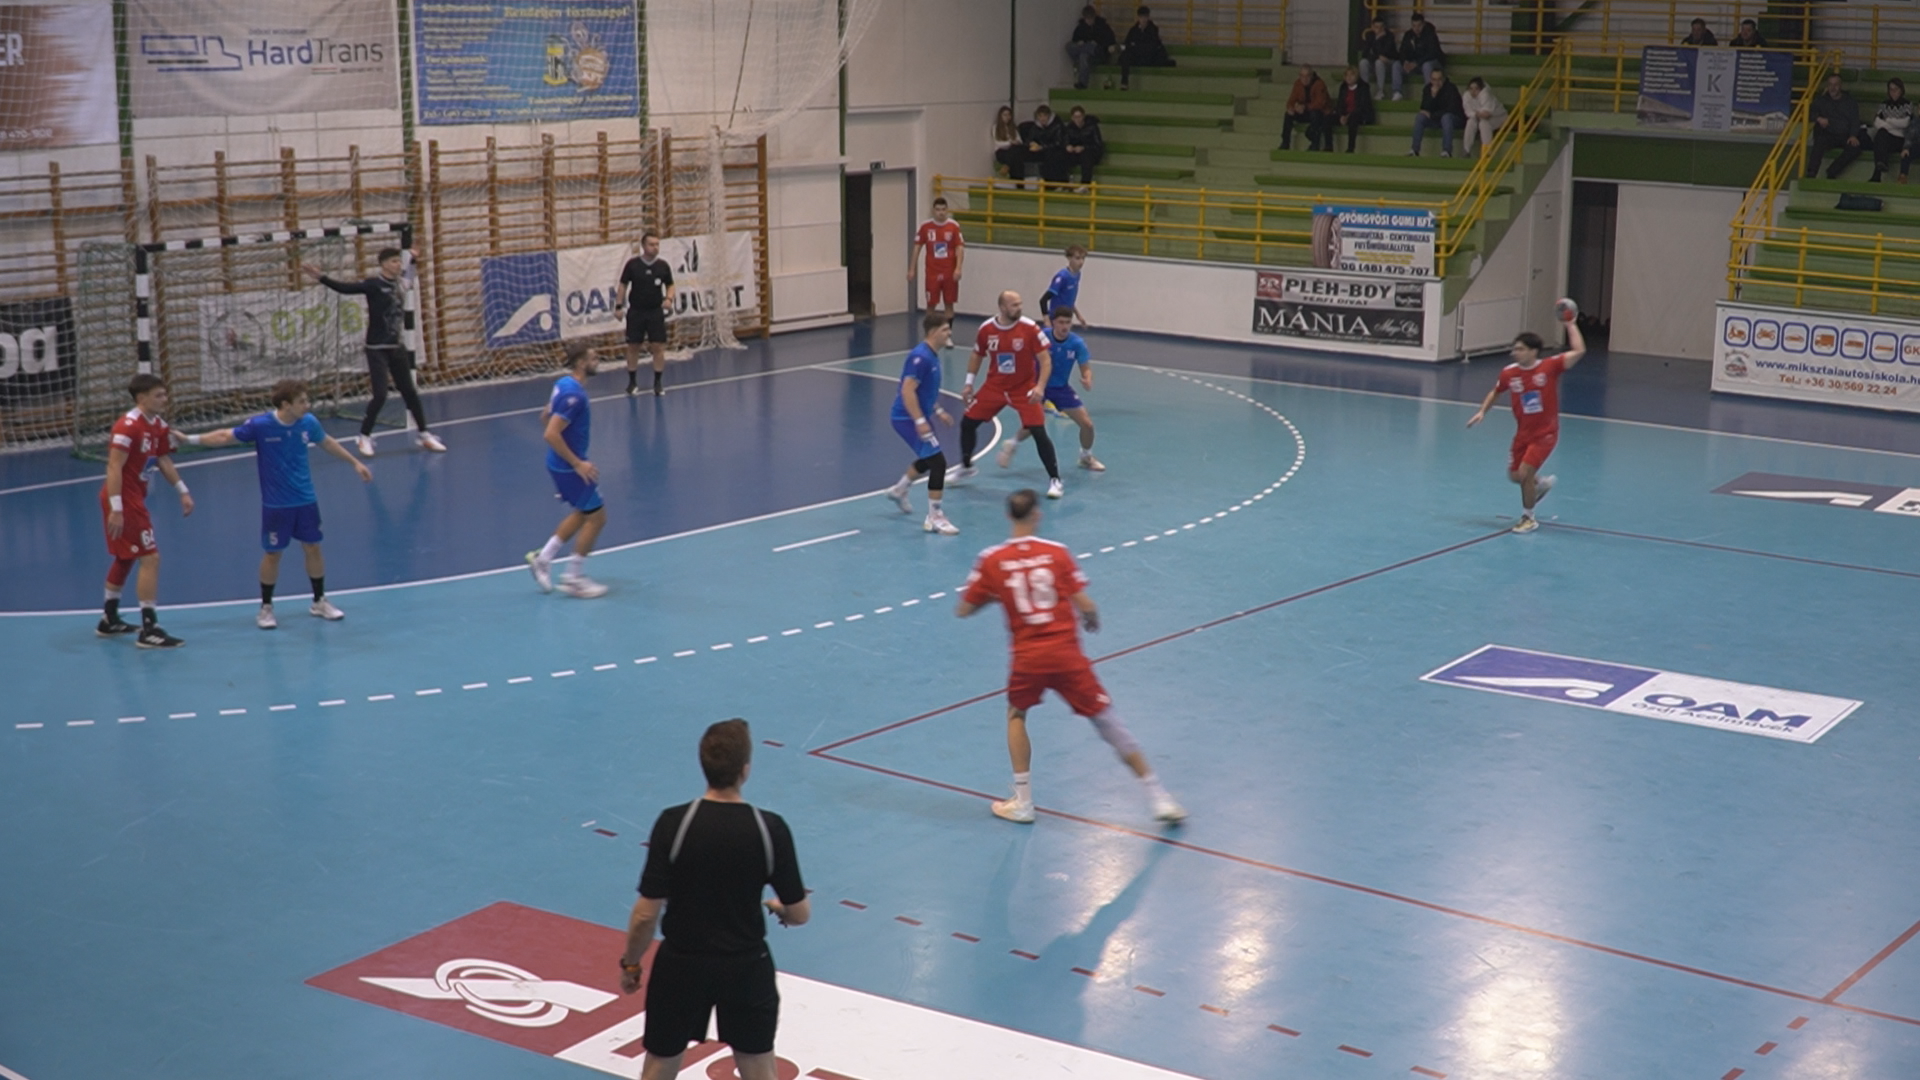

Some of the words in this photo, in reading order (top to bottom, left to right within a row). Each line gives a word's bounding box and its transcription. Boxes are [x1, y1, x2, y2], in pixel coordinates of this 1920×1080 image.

[248, 37, 384, 67] HardTrans
[1707, 73, 1722, 93] K
[1285, 279, 1392, 299] PLÉH-BOY
[1259, 306, 1371, 336] MÁNIA
[1804, 377, 1825, 388] +36
[1867, 383, 1880, 393] 22
[1883, 385, 1898, 396] 24
[269, 531, 279, 546] 5
[1643, 694, 1813, 728] OAM
